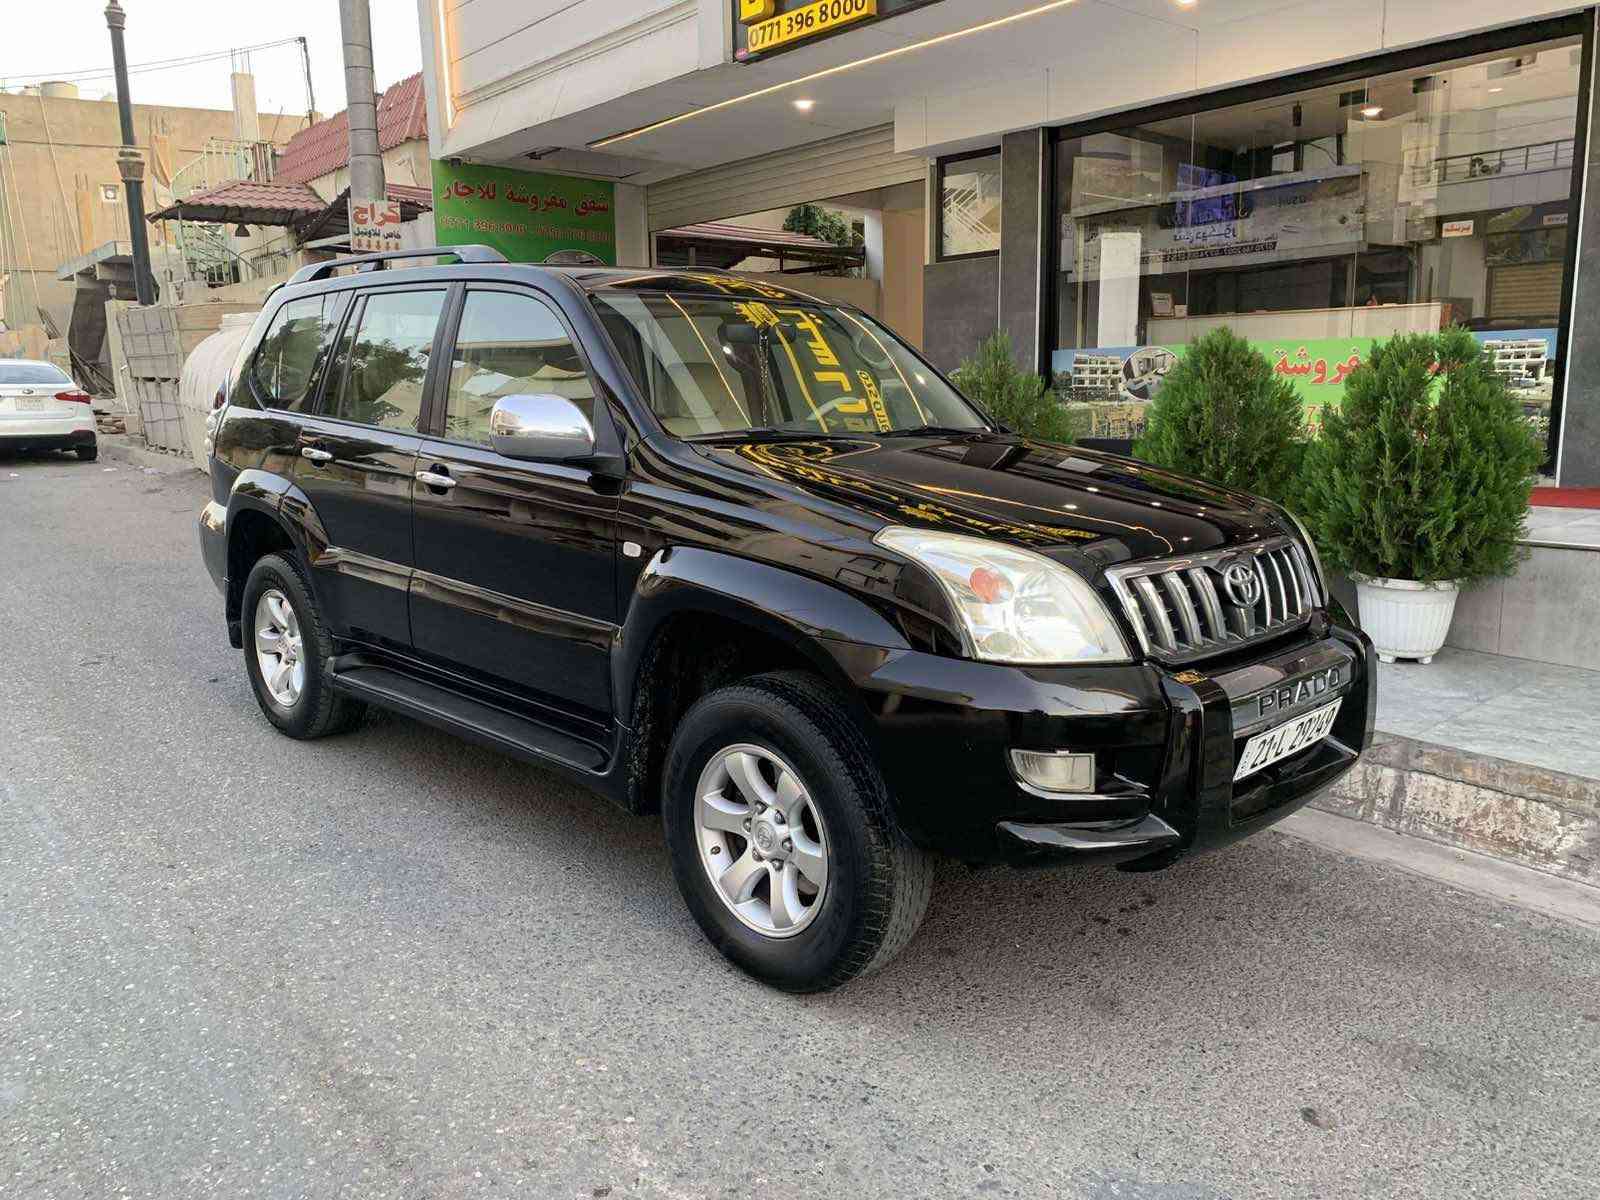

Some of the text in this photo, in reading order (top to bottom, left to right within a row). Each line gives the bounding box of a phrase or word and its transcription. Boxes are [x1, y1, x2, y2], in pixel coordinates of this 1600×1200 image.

[749, 0, 866, 48] 0771 396 8000
[352, 201, 401, 227] كراج
[1272, 346, 1363, 385] فروشة
[1258, 668, 1340, 717] PRADO
